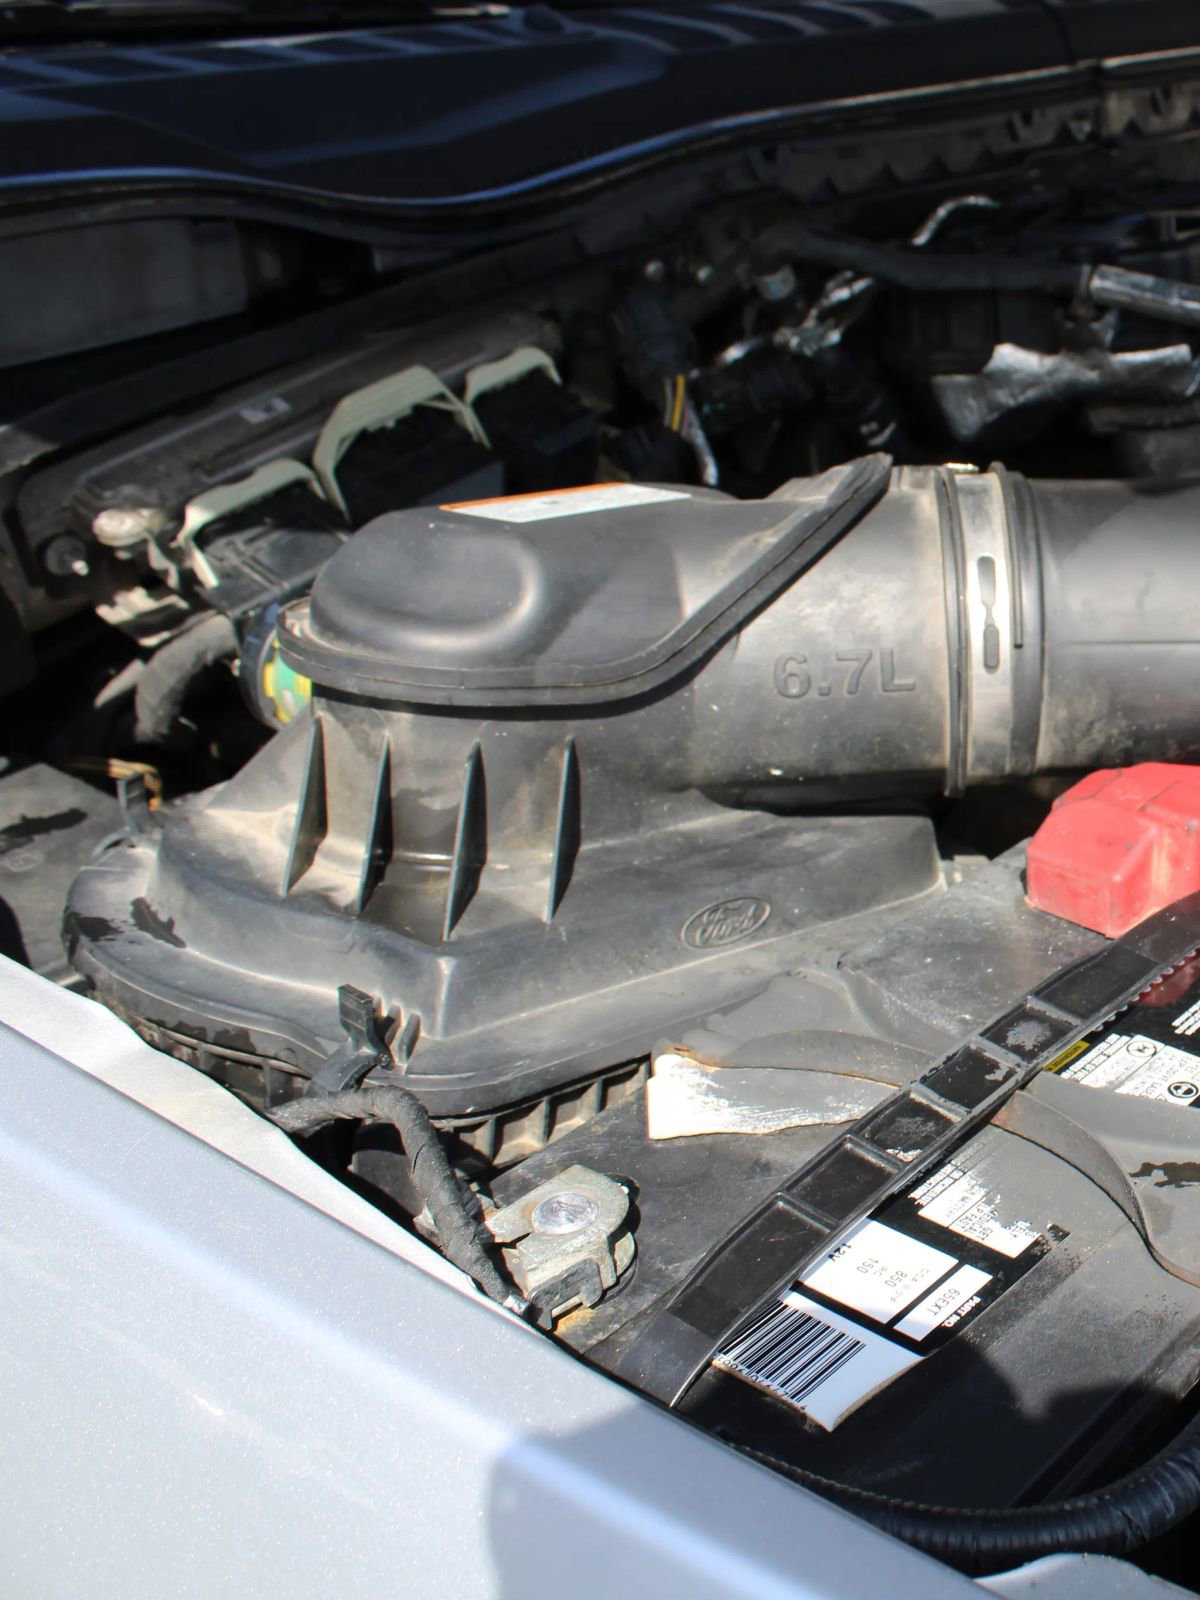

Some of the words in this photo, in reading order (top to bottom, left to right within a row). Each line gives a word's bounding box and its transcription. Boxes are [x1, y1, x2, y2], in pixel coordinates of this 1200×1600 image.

[773, 648, 916, 700] 6.7L
[695, 903, 757, 947] Ford
[828, 1243, 851, 1262] 12V
[856, 1258, 879, 1274] 150
[884, 1270, 907, 1288] 850
[927, 1288, 960, 1315] 65EXT
